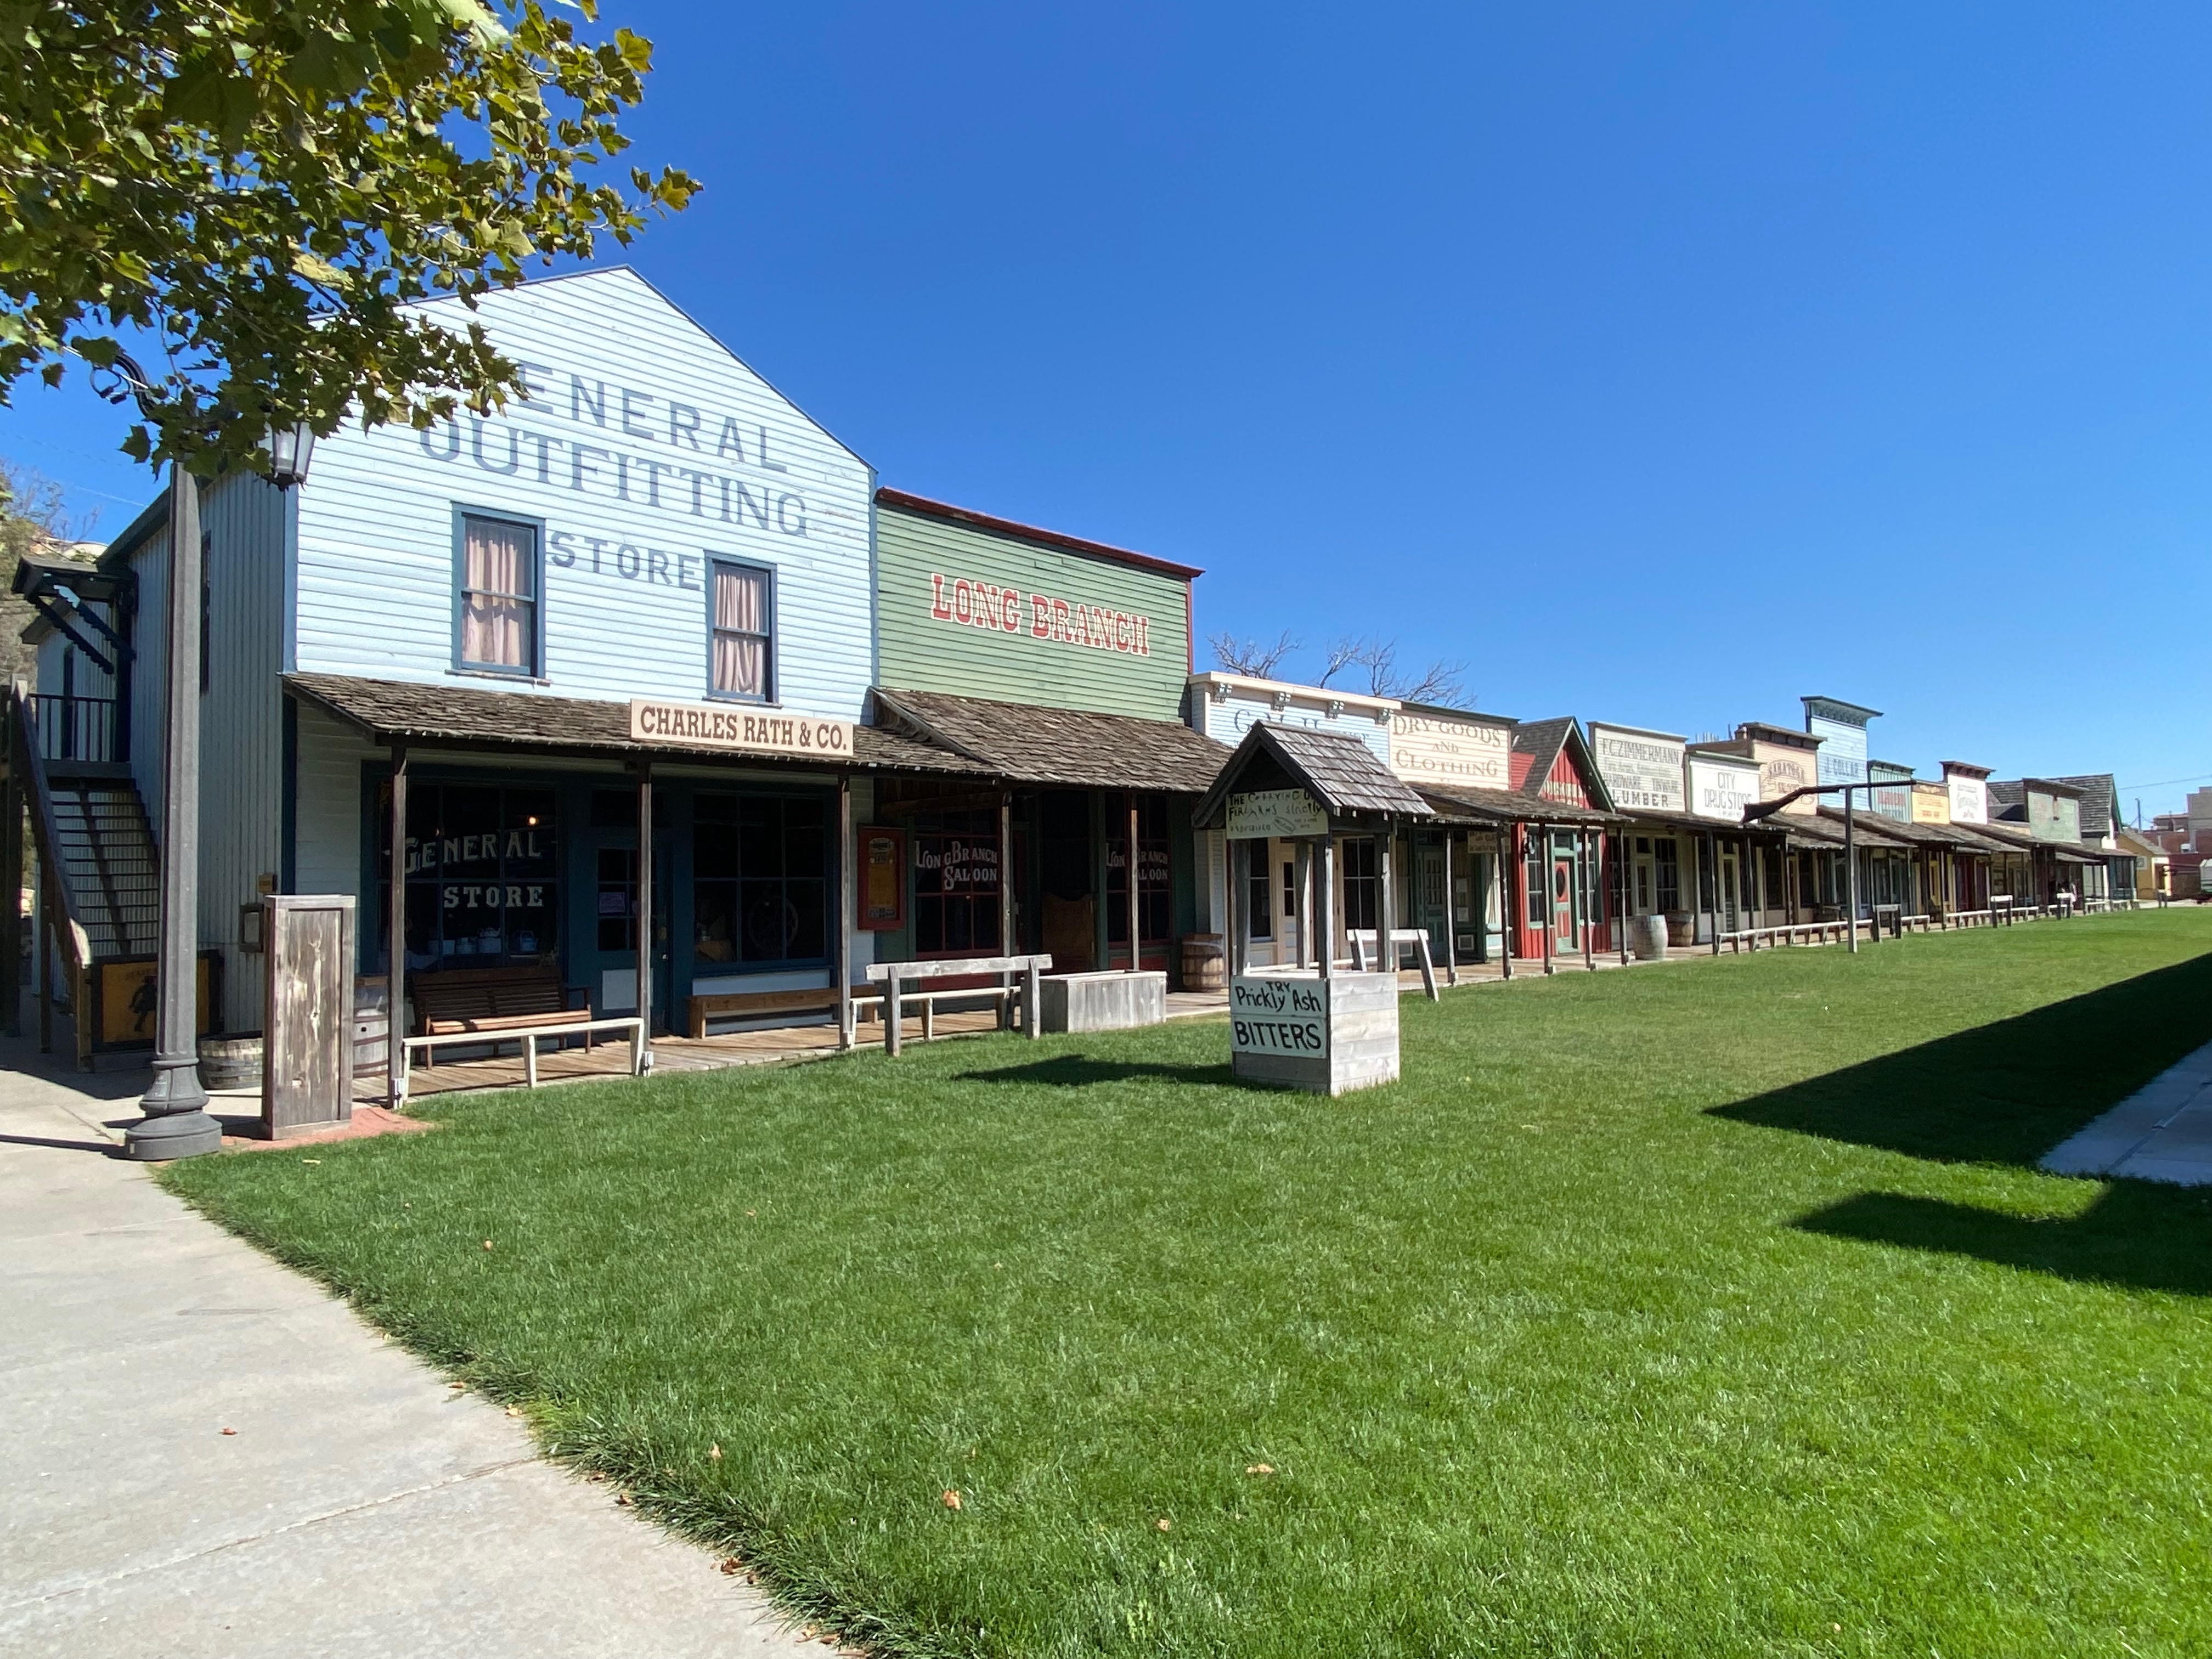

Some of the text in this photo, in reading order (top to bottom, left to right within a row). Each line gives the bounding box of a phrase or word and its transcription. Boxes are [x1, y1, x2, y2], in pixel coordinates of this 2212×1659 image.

[518, 360, 787, 473] ENERAL
[419, 411, 809, 539] OUTFITTING
[550, 531, 701, 591] STORE
[931, 572, 1150, 657] LONG BRANCH
[640, 705, 847, 751] CHARLES RATH & CO.
[1392, 715, 1501, 747] DRY GOODS
[1432, 741, 1459, 753] AND
[1396, 749, 1498, 776] CLOTHING
[1718, 772, 1735, 790] CITY
[1228, 794, 1245, 806] THE
[1612, 789, 1669, 807] LUMBER
[1704, 788, 1726, 809] DRUG
[944, 866, 997, 890] SALOON
[443, 886, 544, 909] STORE
[1234, 985, 1322, 1013] Prickly Ash
[1266, 980, 1291, 992] TRY
[1234, 1020, 1322, 1050] BITTERS
